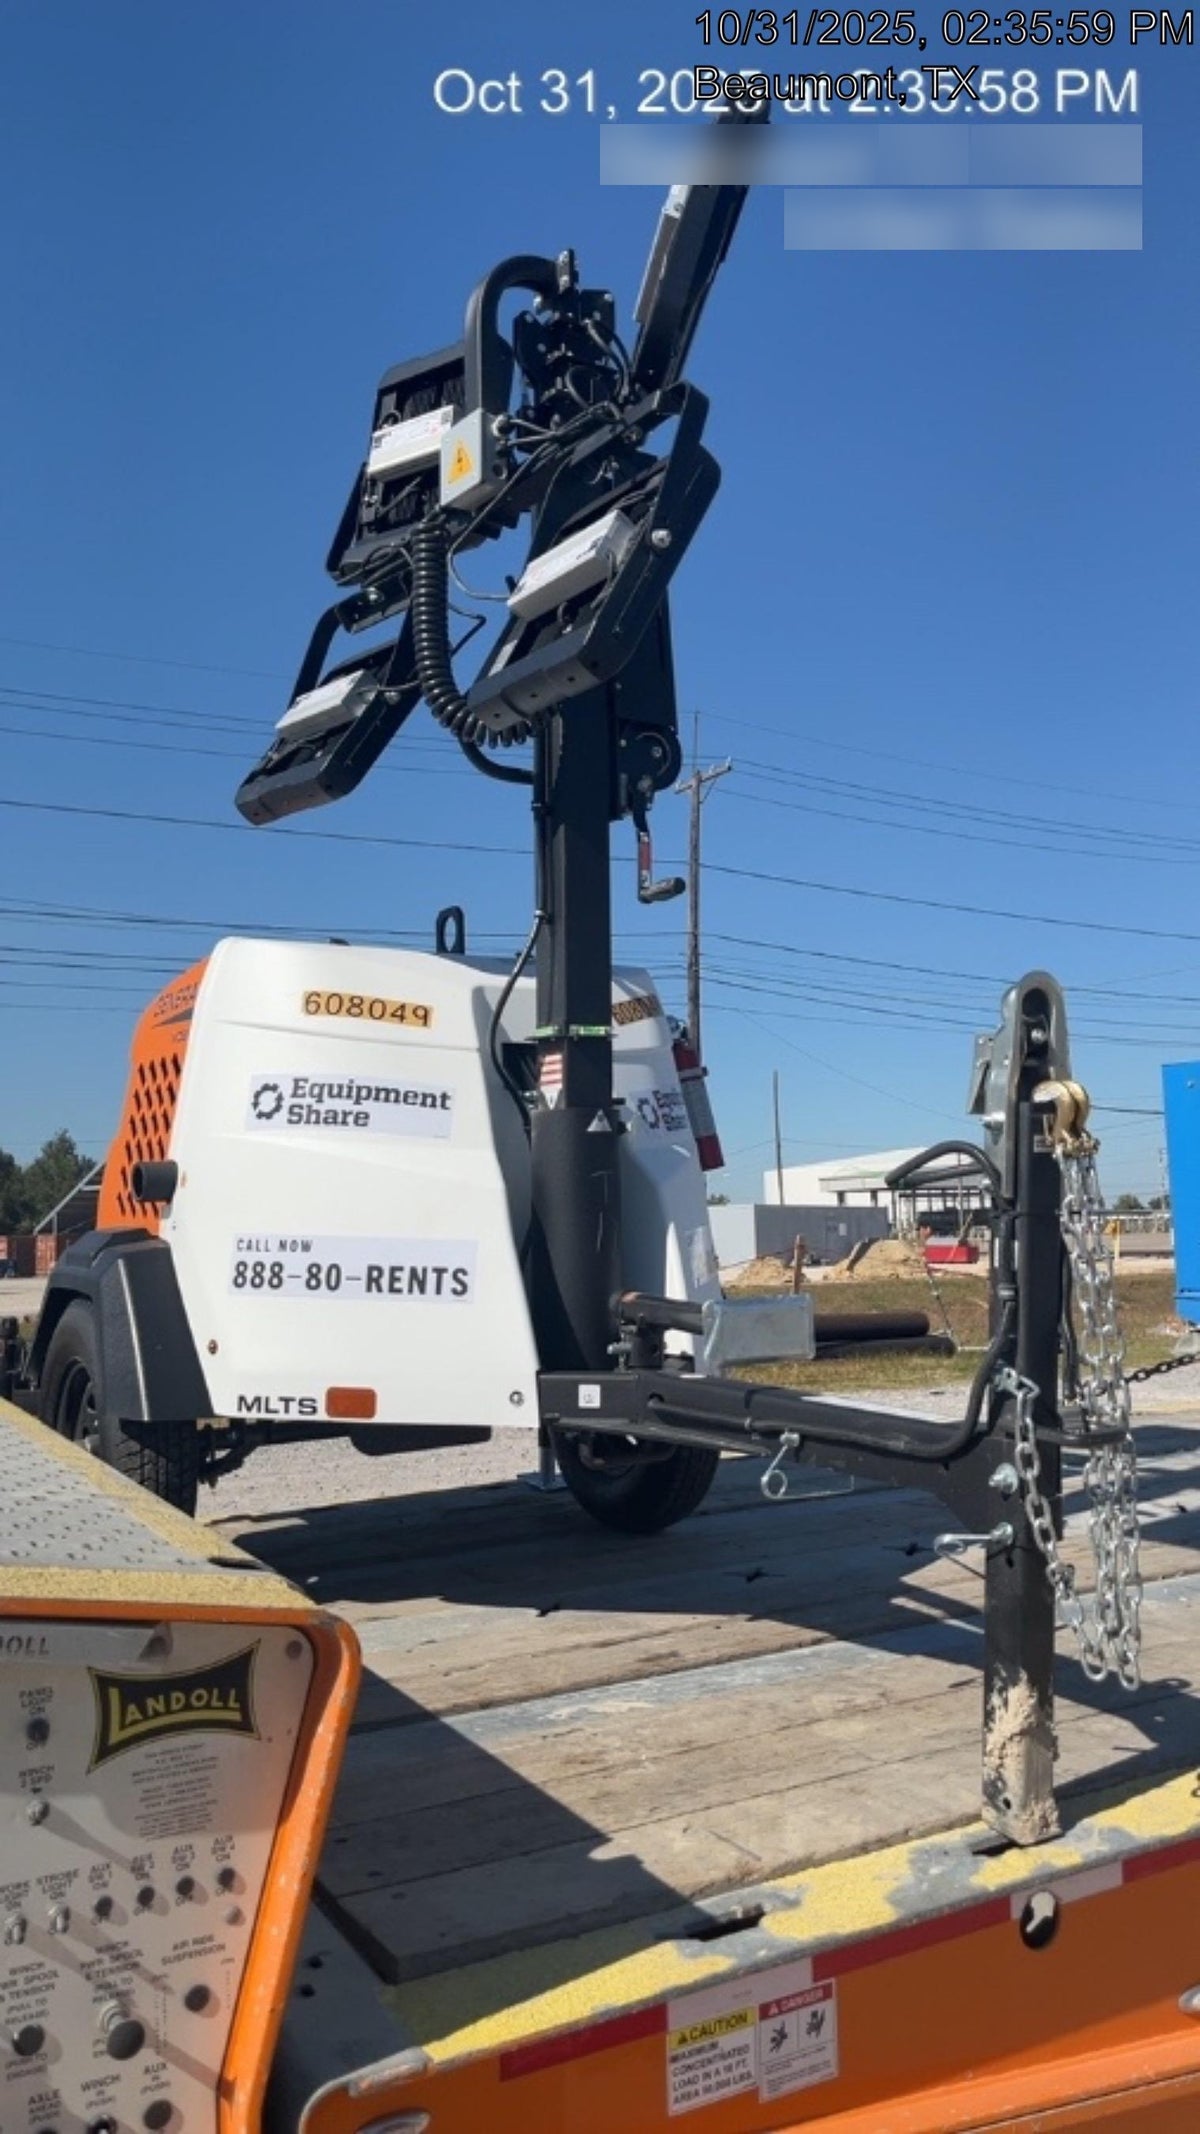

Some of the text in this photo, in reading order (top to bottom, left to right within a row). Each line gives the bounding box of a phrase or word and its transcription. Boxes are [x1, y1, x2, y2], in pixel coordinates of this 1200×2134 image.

[304, 991, 430, 1027] 608049
[290, 1078, 452, 1111] Equipment
[287, 1104, 370, 1127] Share
[236, 1238, 314, 1253] CALL NOW
[232, 1260, 470, 1297] 888-80-RENTS
[236, 1395, 318, 1416] MLTS
[0, 1635, 49, 1656] OLL
[109, 1687, 242, 1746] LANDOLL
[36, 1868, 79, 1886] STROBE
[161, 1943, 226, 1965] SUSPENSION
[688, 2011, 749, 2045] CAUTION
[144, 2062, 168, 2075] AUX
[673, 2071, 700, 2092] LOAD
[702, 2068, 712, 2082] IN
[713, 2065, 721, 2077] A
[81, 2074, 121, 2092] WINCH
